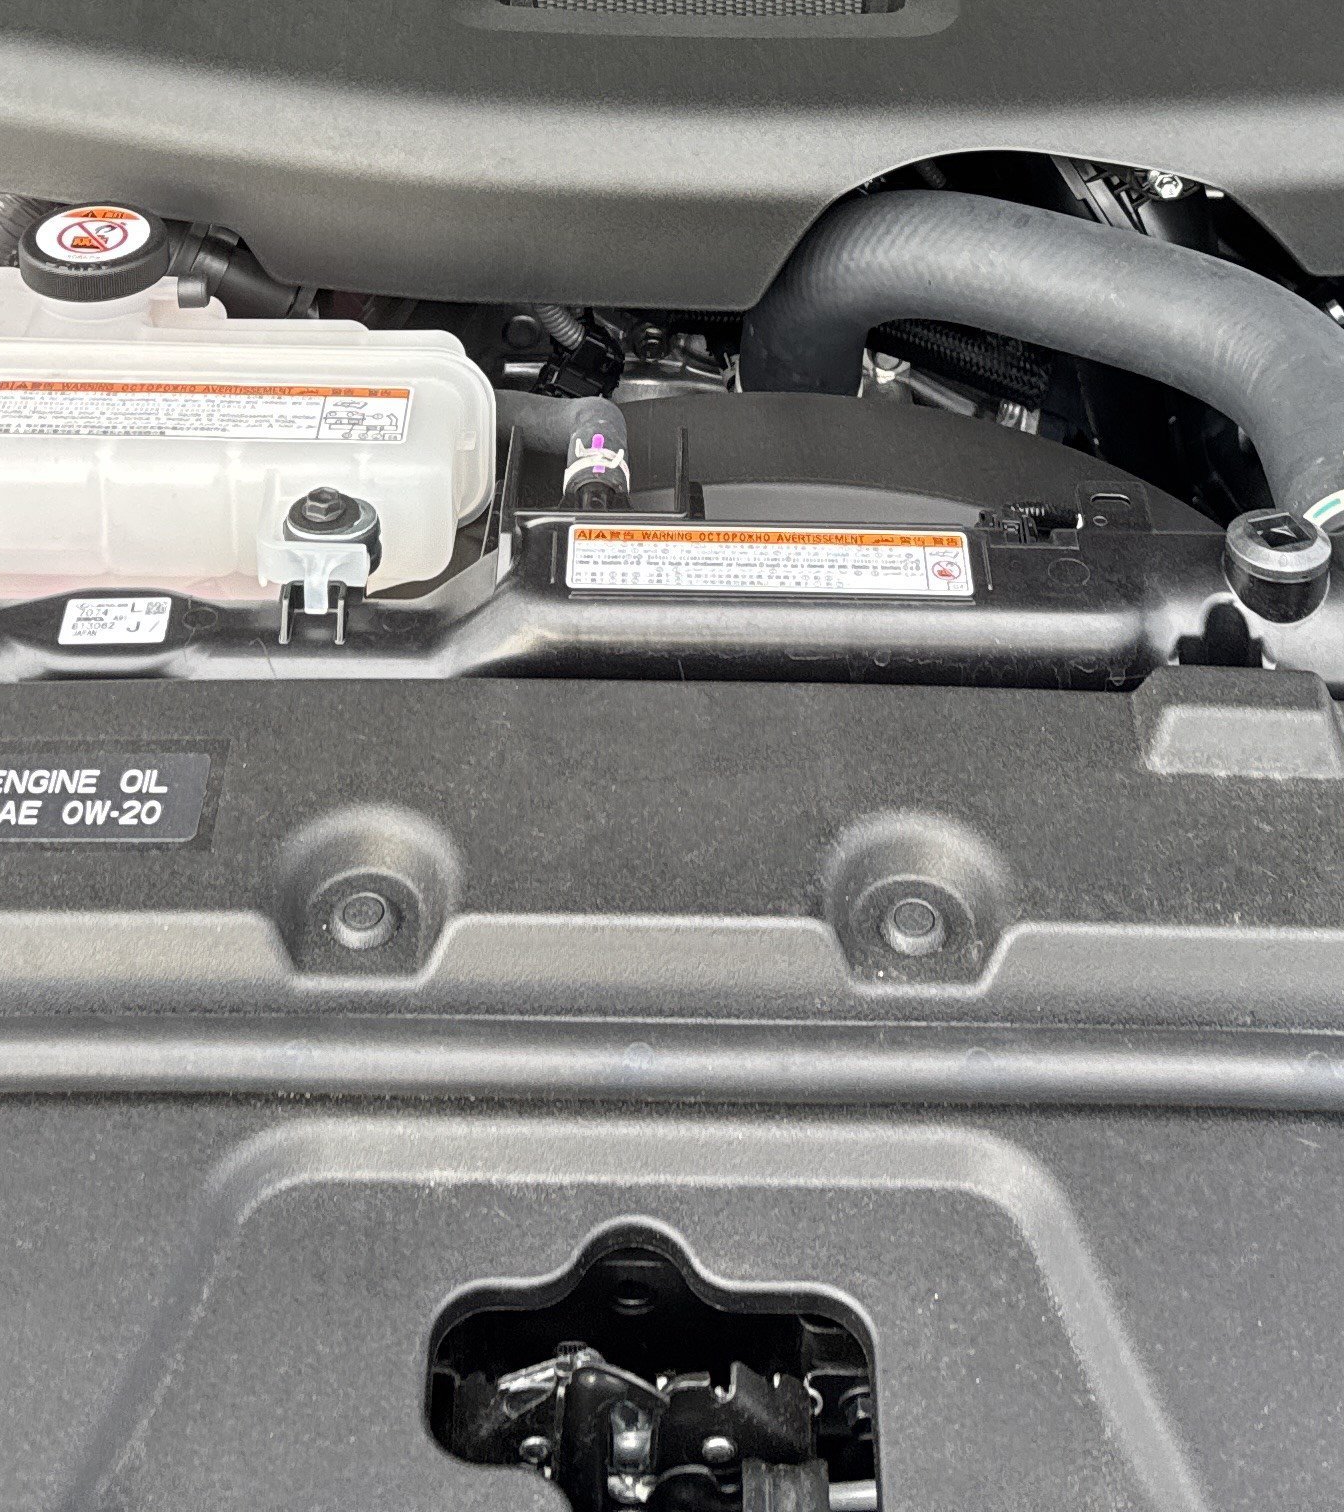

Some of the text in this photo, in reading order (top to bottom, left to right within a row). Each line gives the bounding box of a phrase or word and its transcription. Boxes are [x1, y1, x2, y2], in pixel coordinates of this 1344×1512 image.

[61, 382, 115, 391] WARNING
[641, 531, 693, 541] WARNING
[699, 532, 771, 543] ОСТОРОЖНО
[776, 533, 864, 544] AVERTISSEMENT
[119, 768, 168, 794] OIL
[62, 800, 163, 825] 0W-20
